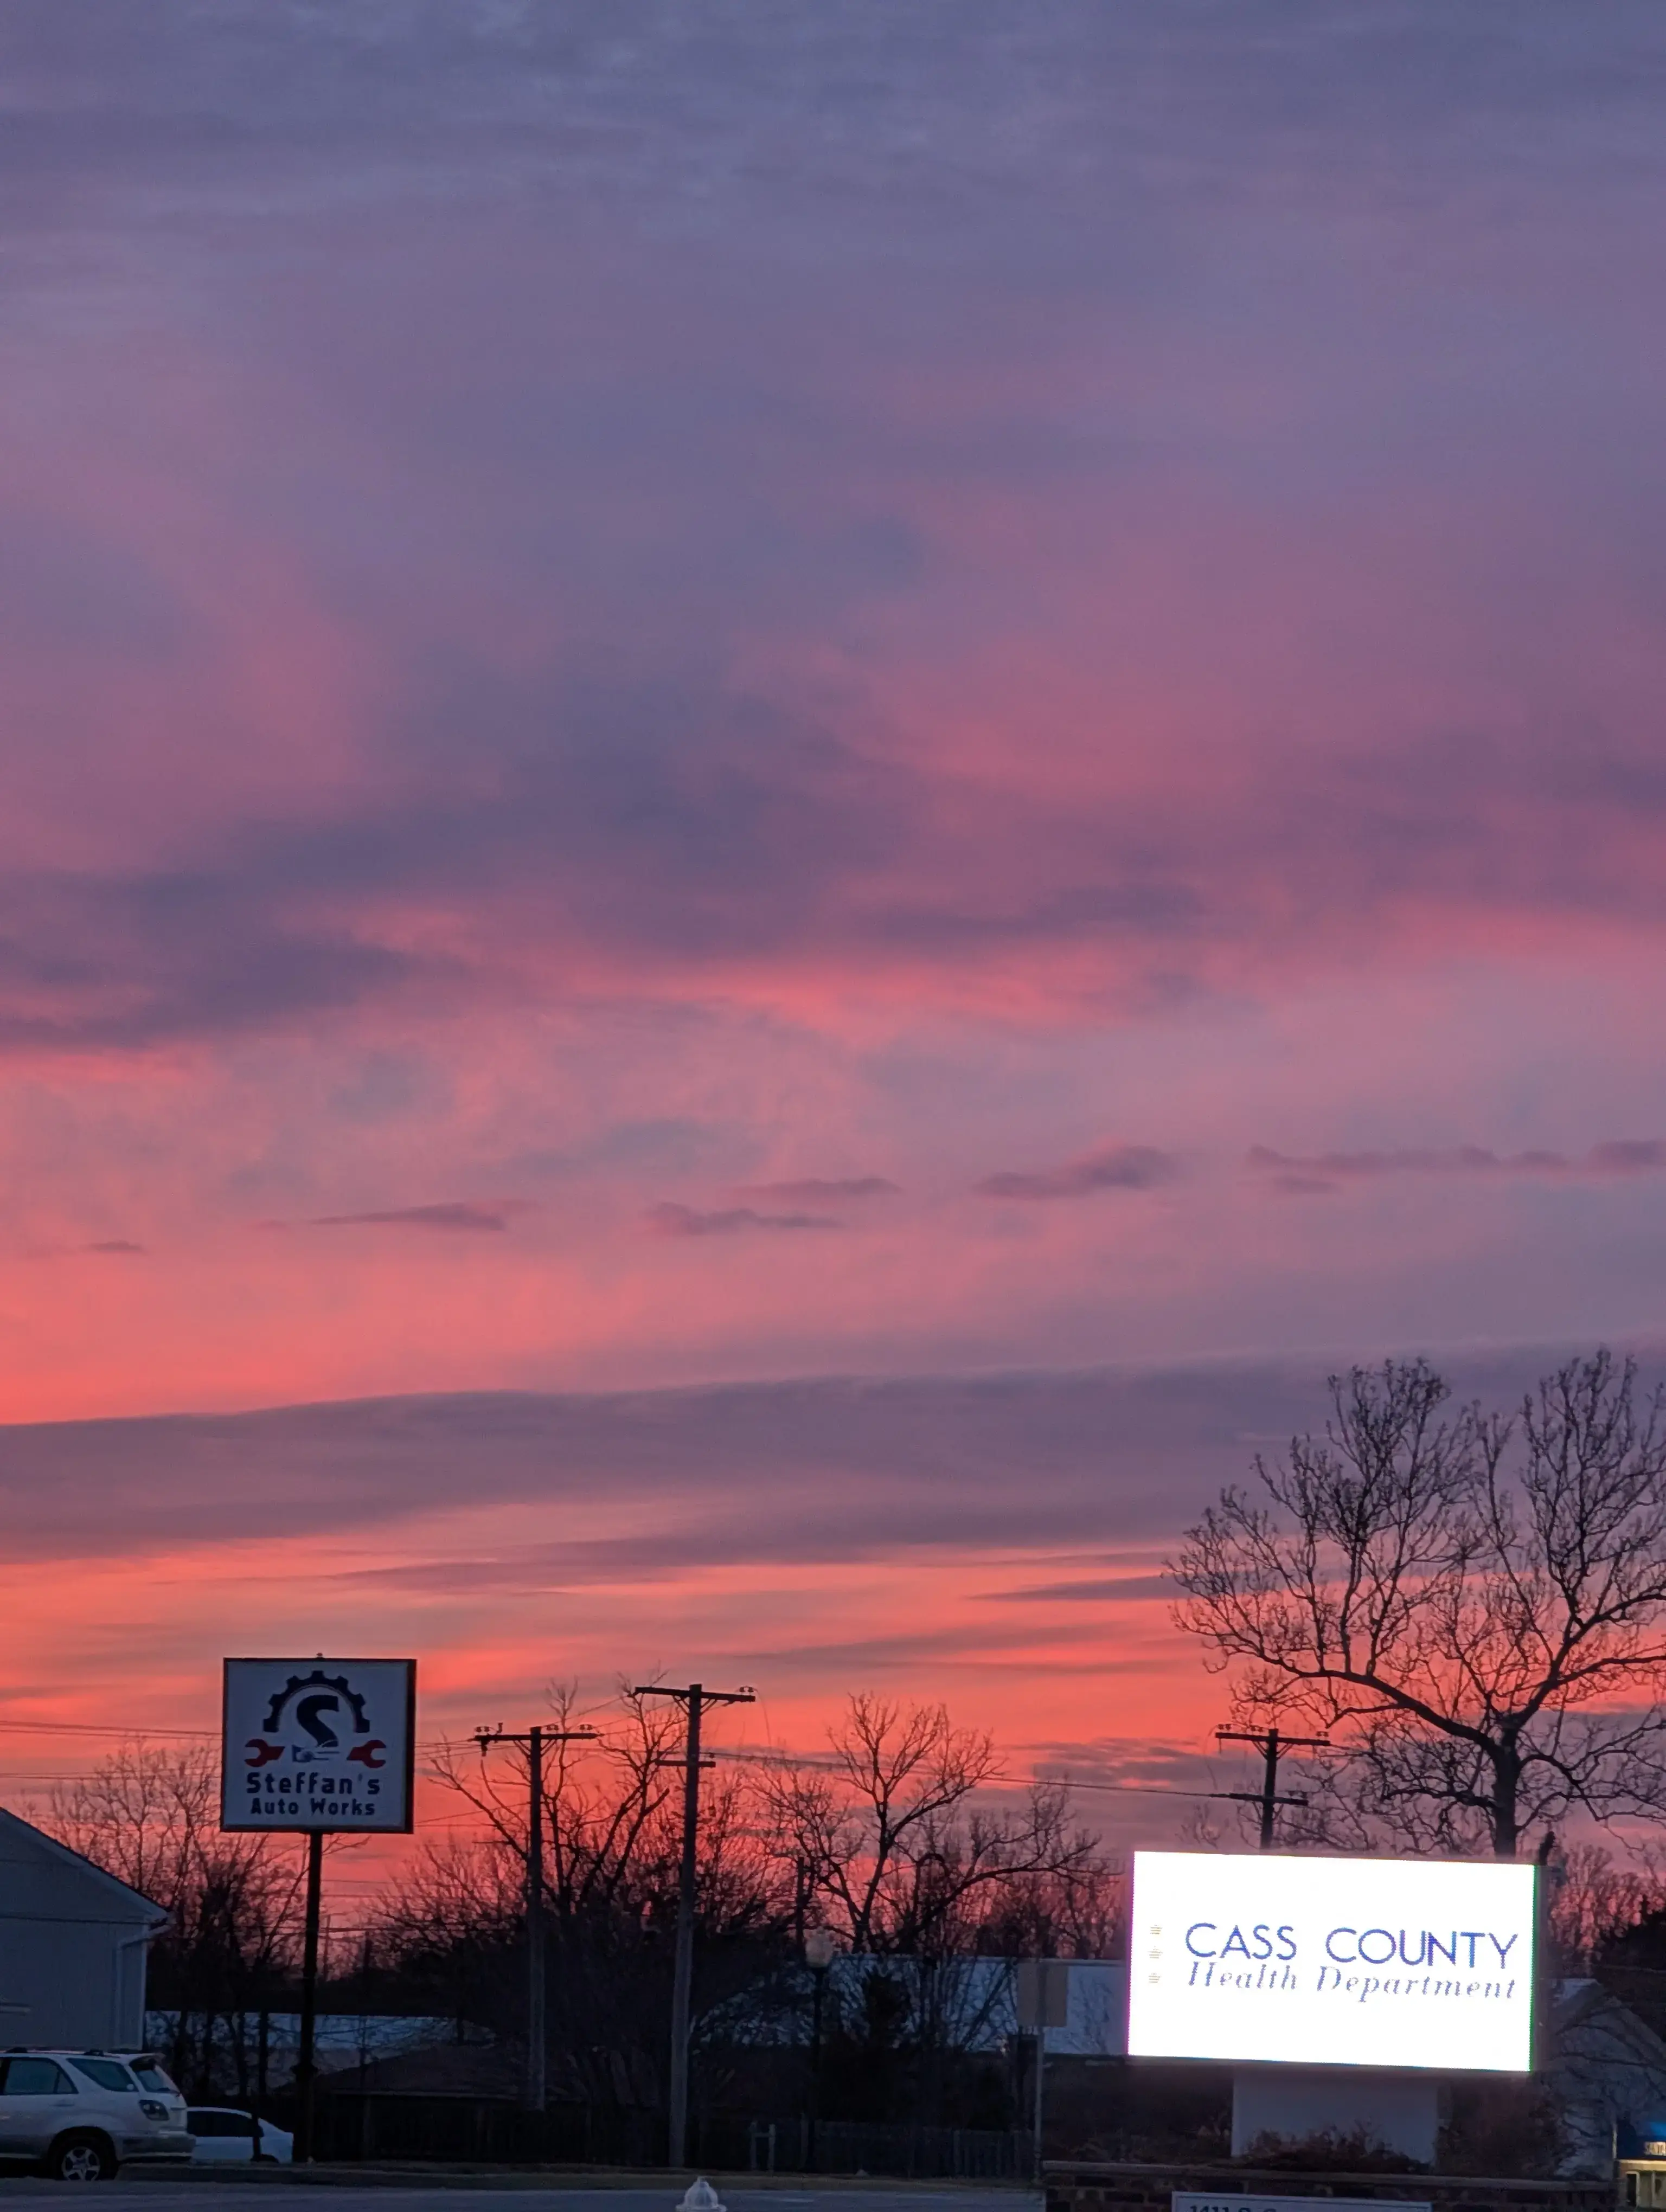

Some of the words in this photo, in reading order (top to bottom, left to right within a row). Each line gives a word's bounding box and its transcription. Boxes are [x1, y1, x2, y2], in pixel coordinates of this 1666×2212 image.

[247, 1772, 380, 1795] Steffan's
[251, 1798, 299, 1815] Auto
[310, 1798, 375, 1816] Works
[1186, 1922, 1297, 1960] CASS
[1325, 1927, 1518, 1969] COUNTY
[1188, 1961, 1297, 1990] Health
[1317, 1966, 1515, 2003] Department
